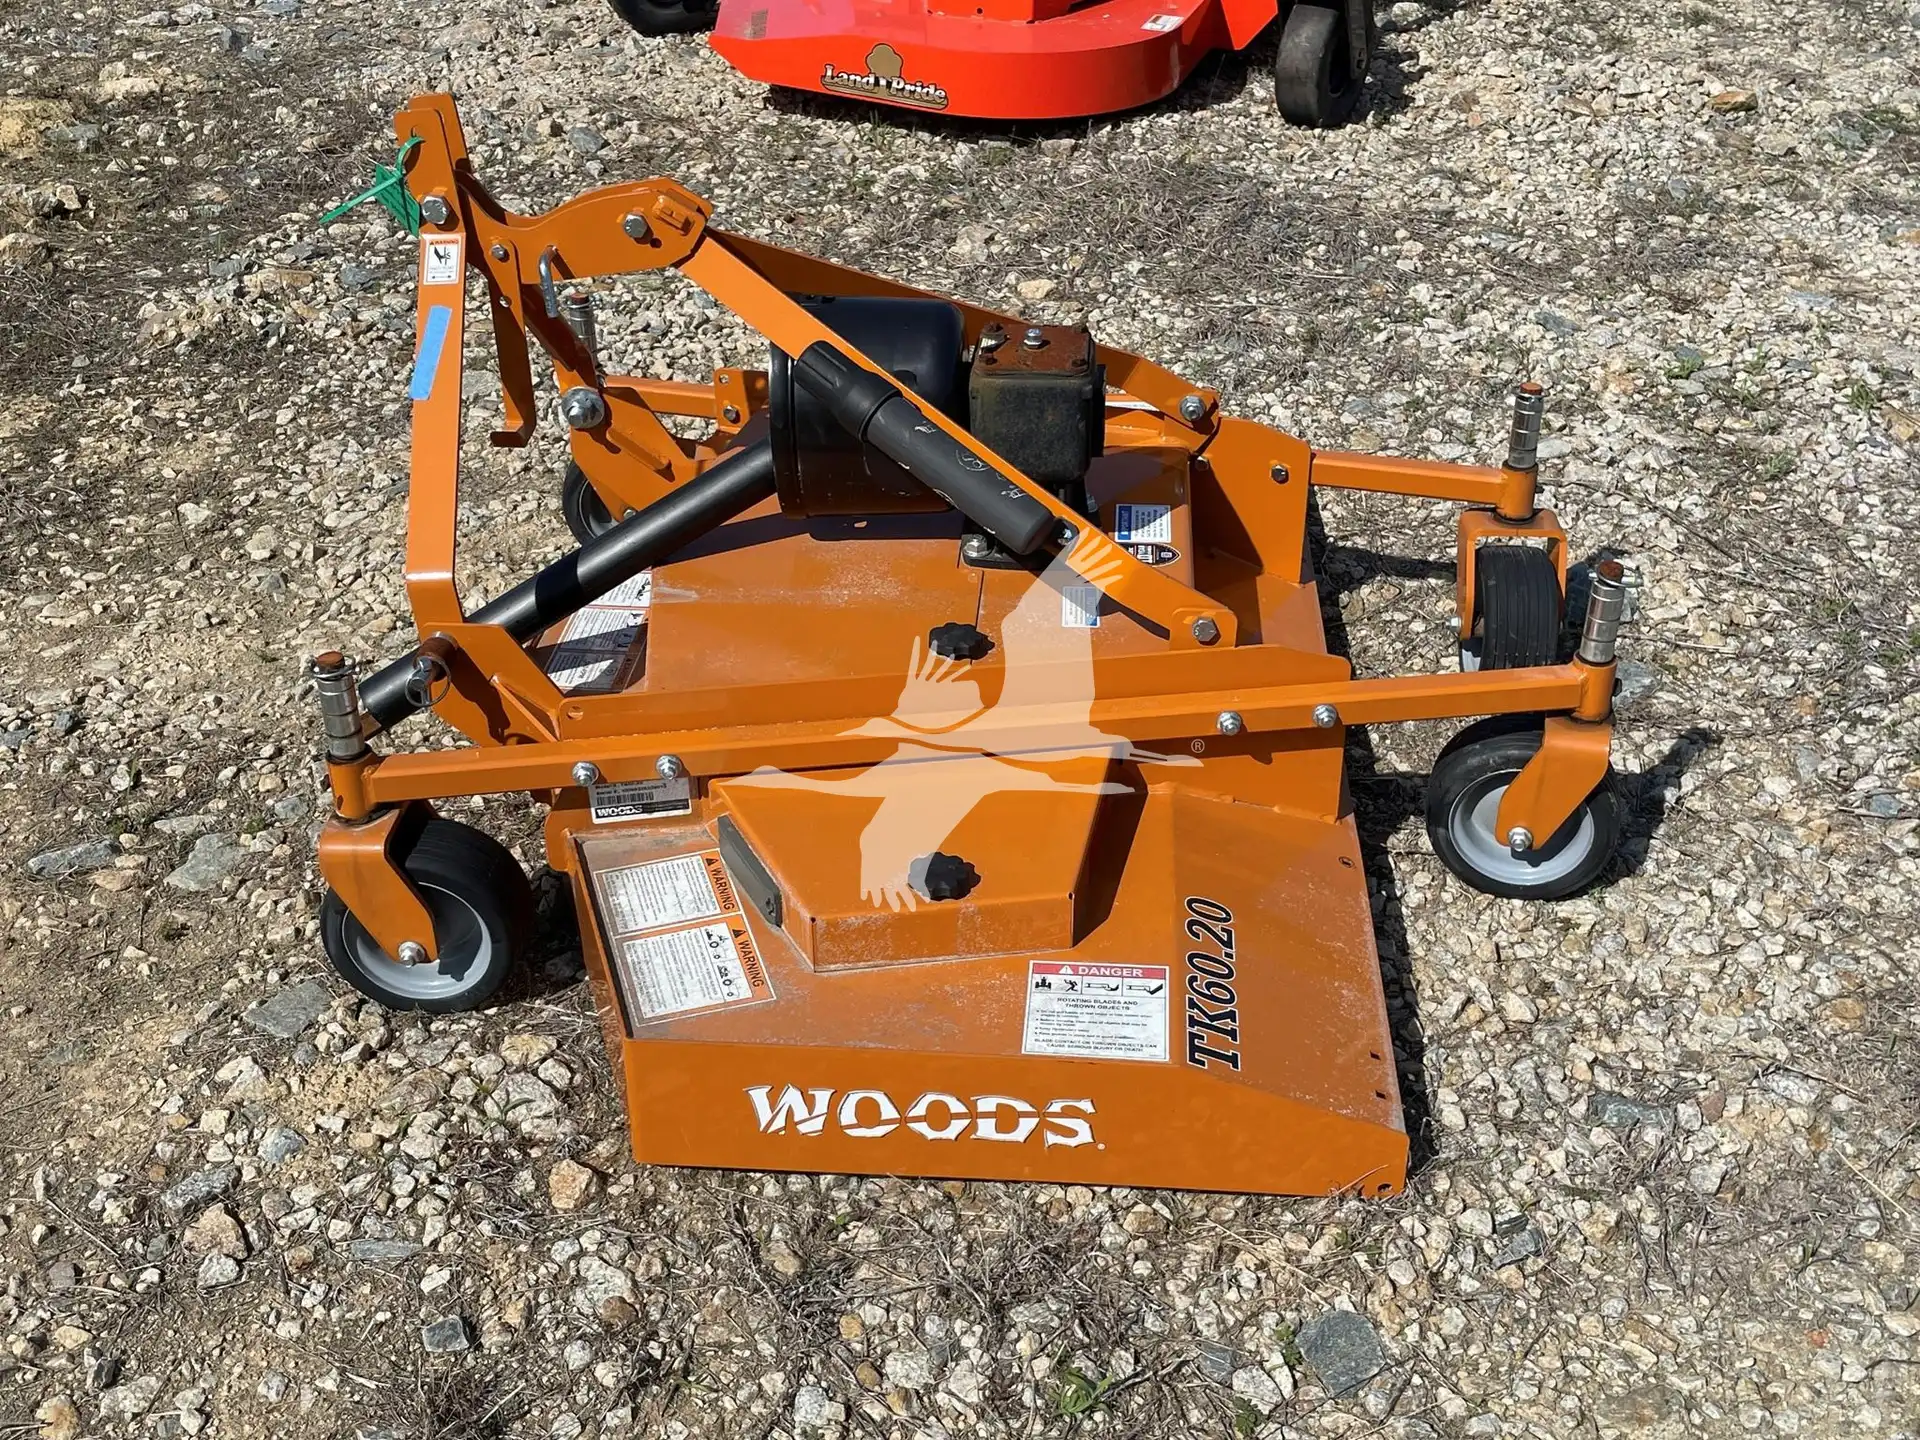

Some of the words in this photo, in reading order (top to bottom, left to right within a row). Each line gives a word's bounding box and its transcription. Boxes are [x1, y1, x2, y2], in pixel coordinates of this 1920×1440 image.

[823, 63, 877, 91] Land
[888, 76, 947, 104] Pride
[596, 805, 643, 817] WOODS
[710, 868, 736, 911] WARNING
[737, 939, 765, 988] WARNING
[1077, 966, 1144, 978] DANGER
[1184, 895, 1242, 1072] TK60.20
[742, 1083, 1097, 1150] WOODS
